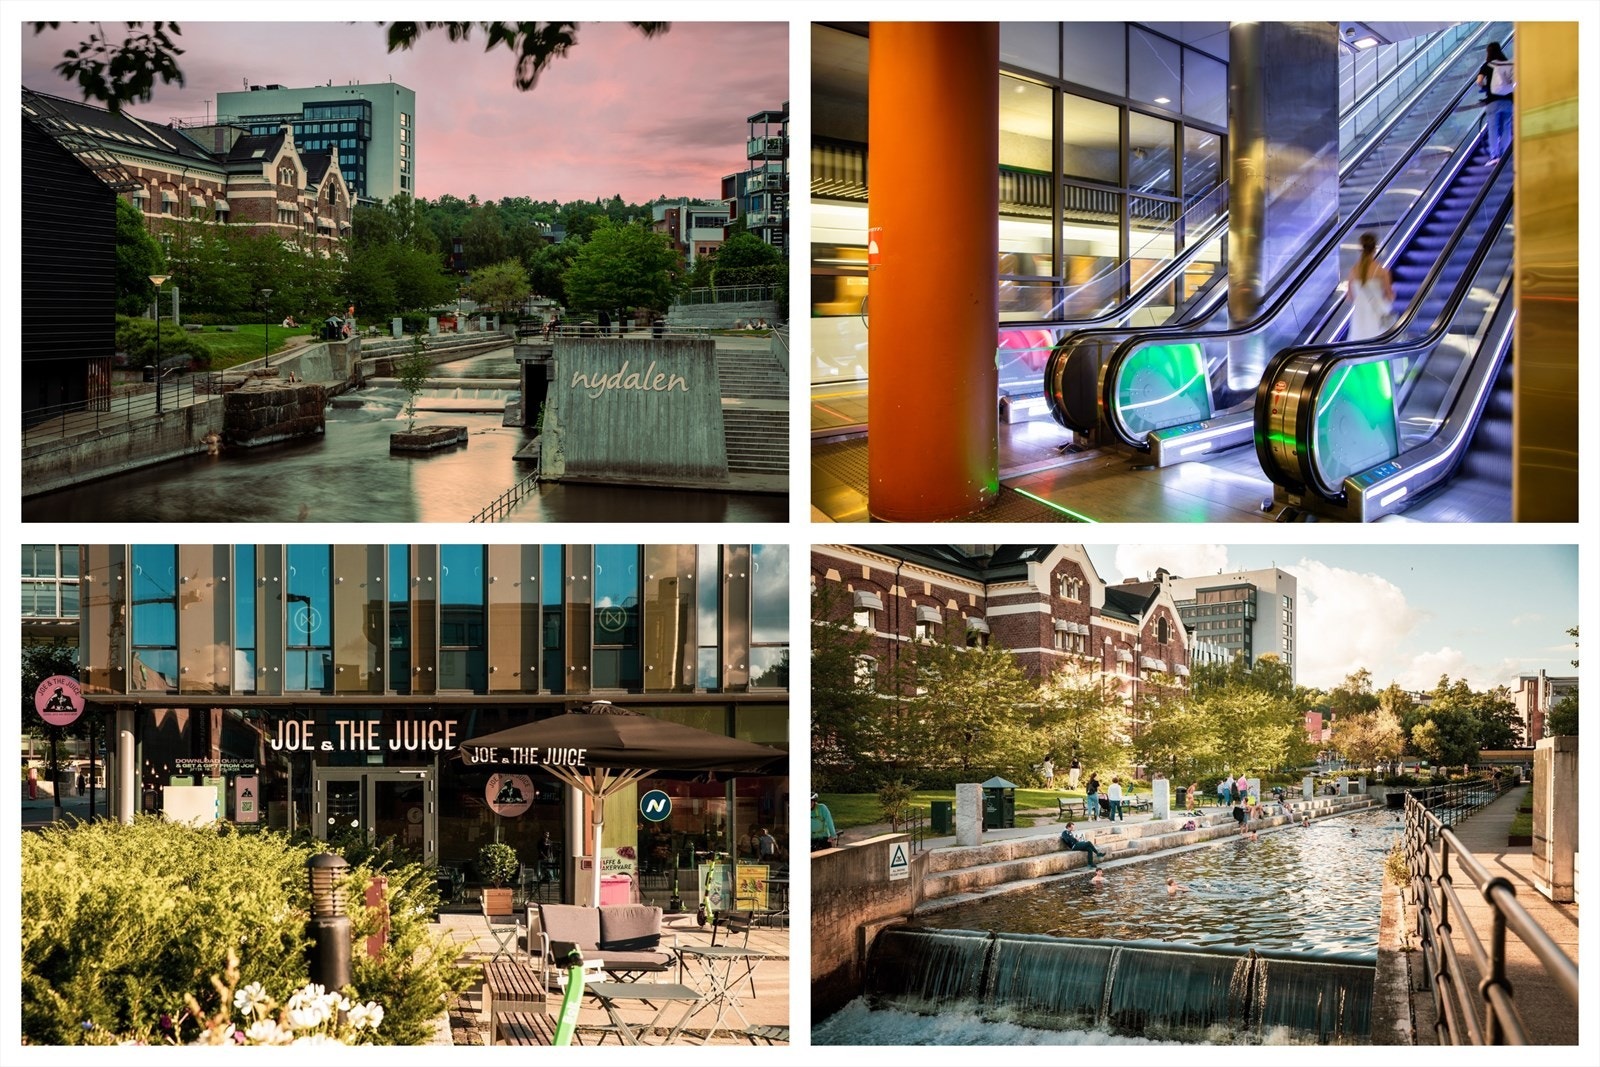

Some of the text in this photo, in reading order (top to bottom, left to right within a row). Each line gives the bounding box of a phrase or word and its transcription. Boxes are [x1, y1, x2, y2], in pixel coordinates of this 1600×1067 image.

[571, 360, 690, 399] nydalen
[38, 683, 49, 696] JOE
[65, 681, 81, 696] JUICE
[271, 720, 458, 751] JOE & THE JUICE
[471, 746, 498, 763] JOE
[510, 747, 539, 764] THE
[543, 747, 587, 766] JUICE
[489, 776, 499, 788] JOE
